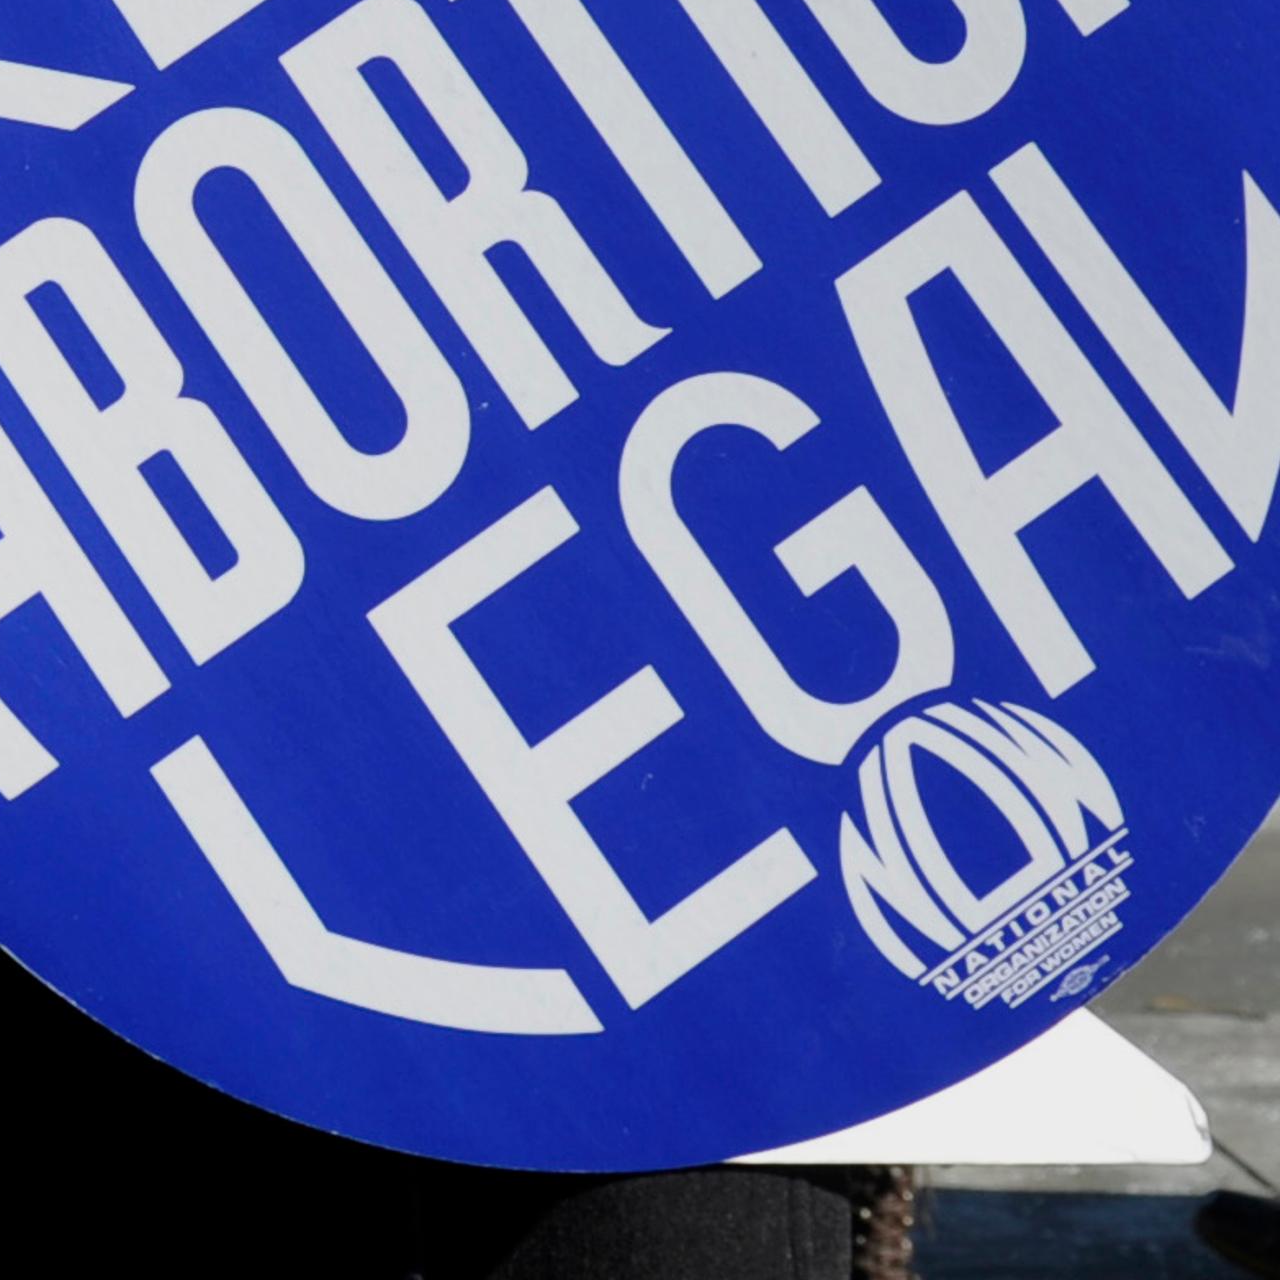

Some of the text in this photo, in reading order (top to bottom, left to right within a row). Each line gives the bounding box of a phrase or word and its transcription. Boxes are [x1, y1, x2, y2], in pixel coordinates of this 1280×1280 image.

[151, 142, 1280, 1034] LEGAL
[839, 697, 1126, 980] NOW
[932, 847, 1130, 996] NATIONAL
[963, 877, 1128, 1005] ORGANIZATION
[1001, 971, 1042, 1004] FOR
[1041, 911, 1120, 973] WOMEN
